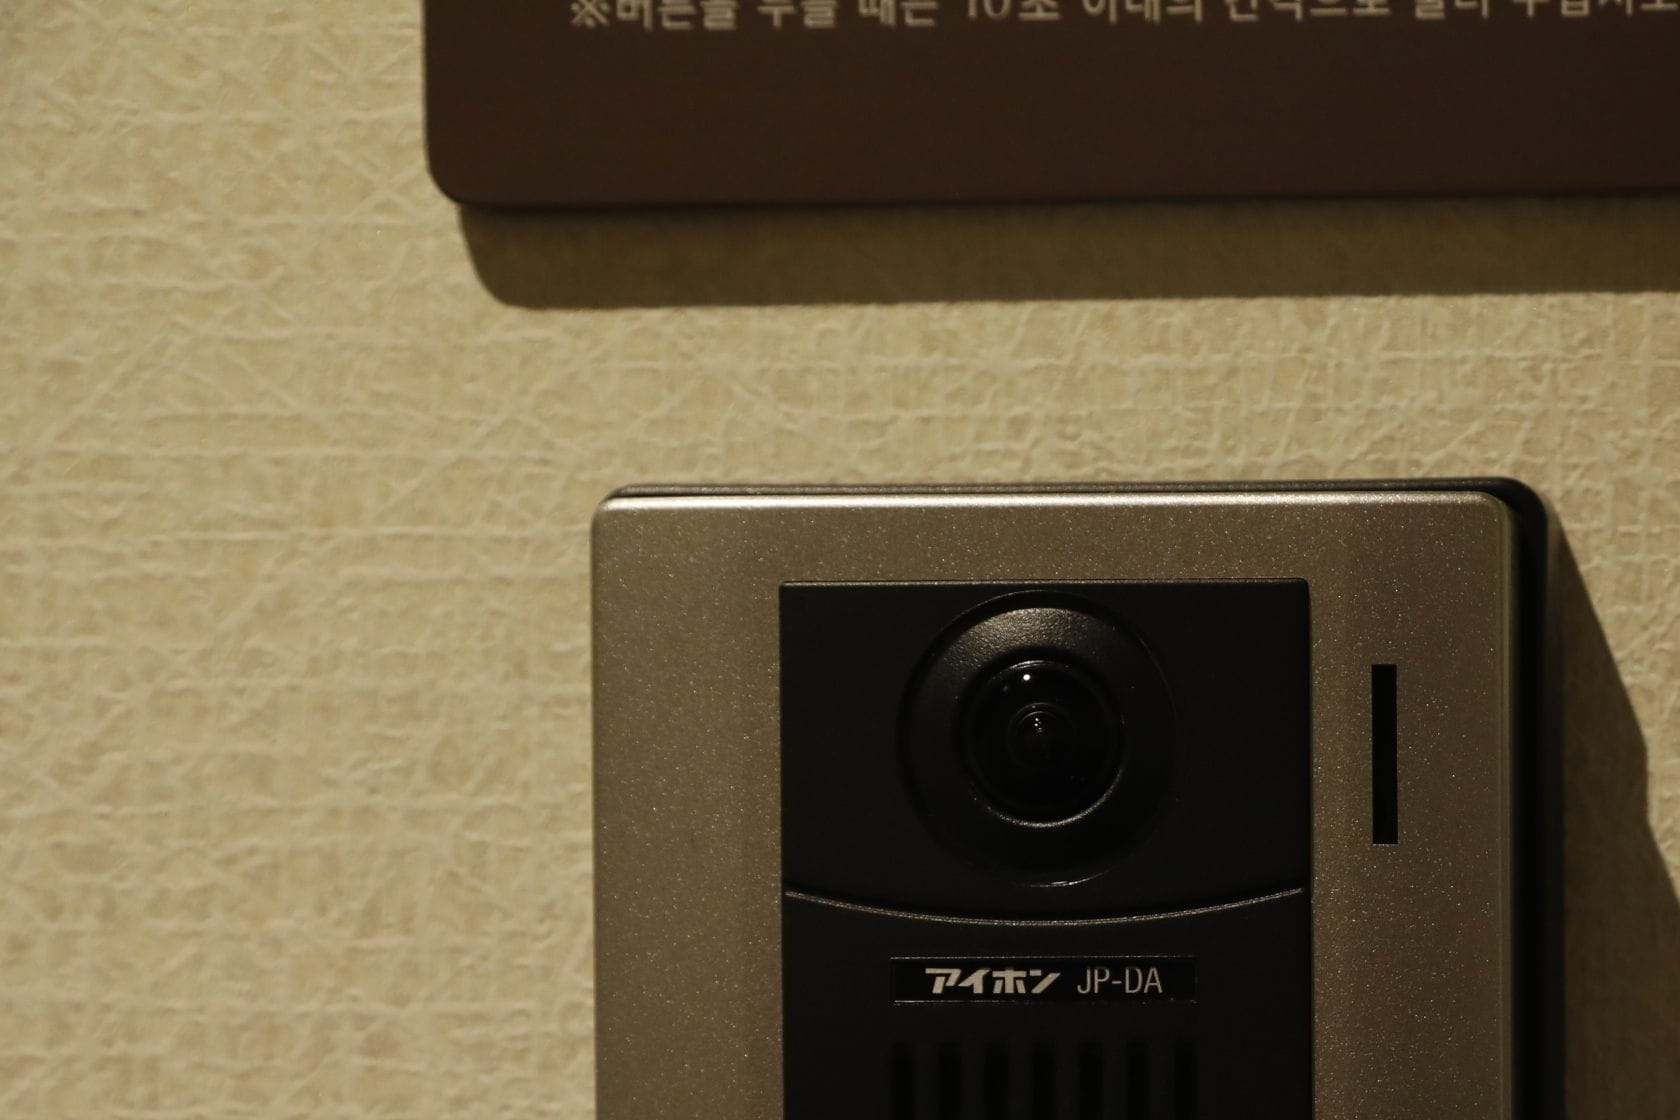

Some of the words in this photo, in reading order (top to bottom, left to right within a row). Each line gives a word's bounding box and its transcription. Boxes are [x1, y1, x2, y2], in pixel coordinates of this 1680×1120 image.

[926, 968, 1060, 993] アイホン
[1078, 968, 1162, 993] JP-DA
